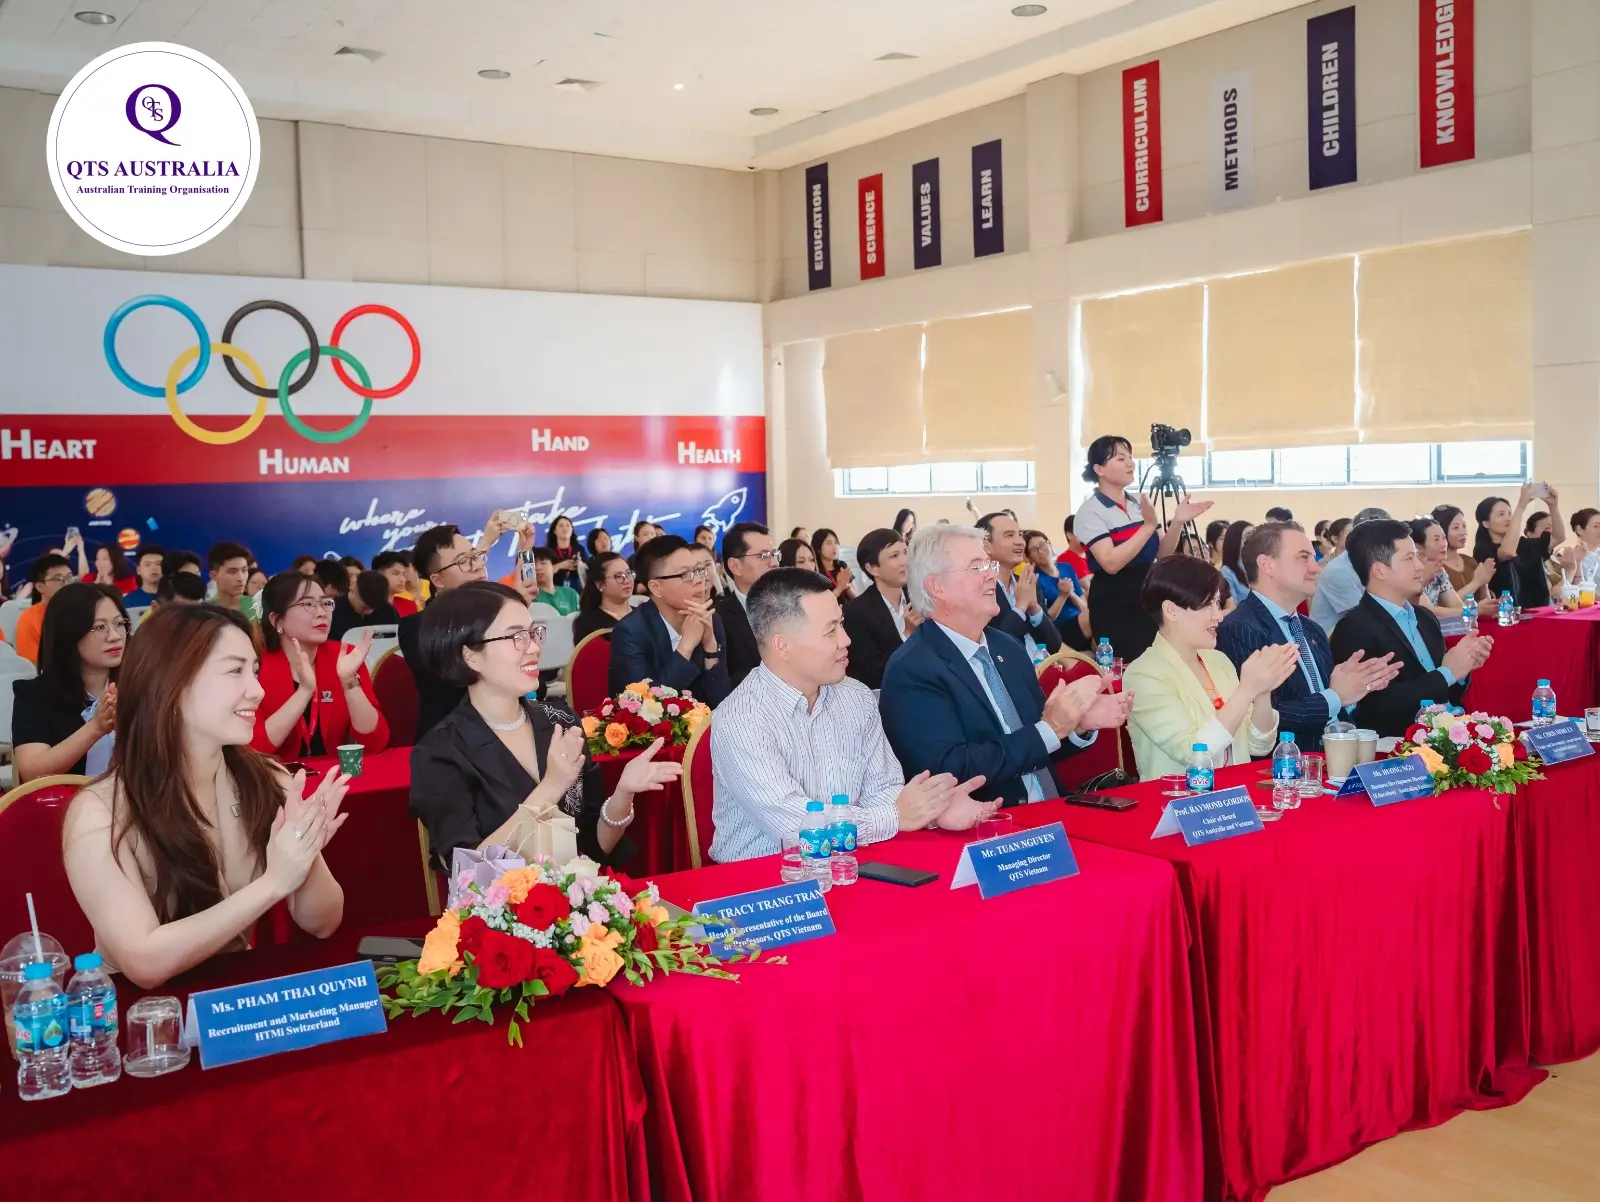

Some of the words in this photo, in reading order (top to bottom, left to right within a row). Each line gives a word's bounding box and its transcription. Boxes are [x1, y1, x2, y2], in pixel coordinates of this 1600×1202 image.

[1321, 41, 1339, 157] CHILDREN
[1133, 78, 1150, 212] CURRICULUM
[1223, 87, 1239, 192] METHODS
[920, 182, 932, 248] VALUES
[980, 168, 993, 230] LEARN
[812, 183, 824, 271] EDUCATION
[865, 190, 877, 265] SCIENCE
[339, 498, 426, 534] where
[1189, 800, 1223, 814] RAYMOND
[1223, 794, 1252, 807] GORDON
[1202, 816, 1217, 825] Chair
[1217, 814, 1223, 822] of
[981, 850, 997, 859] Mr.
[996, 842, 1020, 855] TUAN
[1020, 833, 1056, 848] NGUYEN
[1192, 830, 1205, 838] QTS
[997, 858, 1029, 872] Managing
[1027, 852, 1051, 864] Director
[1009, 871, 1024, 882] QTS
[1024, 866, 1048, 877] Vietnam
[718, 903, 756, 920] TRACY
[756, 895, 794, 911] TRANG
[794, 888, 823, 903] TRAN
[708, 928, 730, 940] Head
[730, 917, 784, 936] Rresentative
[784, 915, 793, 924] of
[793, 912, 805, 922] the
[805, 907, 828, 919] Board
[773, 929, 791, 941] QTS
[792, 923, 823, 935] Vietnam
[211, 1002, 235, 1014] Ms.
[237, 991, 279, 1010] PHAM
[281, 984, 316, 1001] THAI
[318, 975, 368, 996] QUYNH
[208, 1020, 267, 1038] Recruitment
[270, 1015, 288, 1026] and
[289, 1006, 338, 1025] Marketing
[339, 999, 379, 1014] Manager
[255, 1028, 285, 1042] HTMi
[286, 1017, 341, 1037] Switzerland
